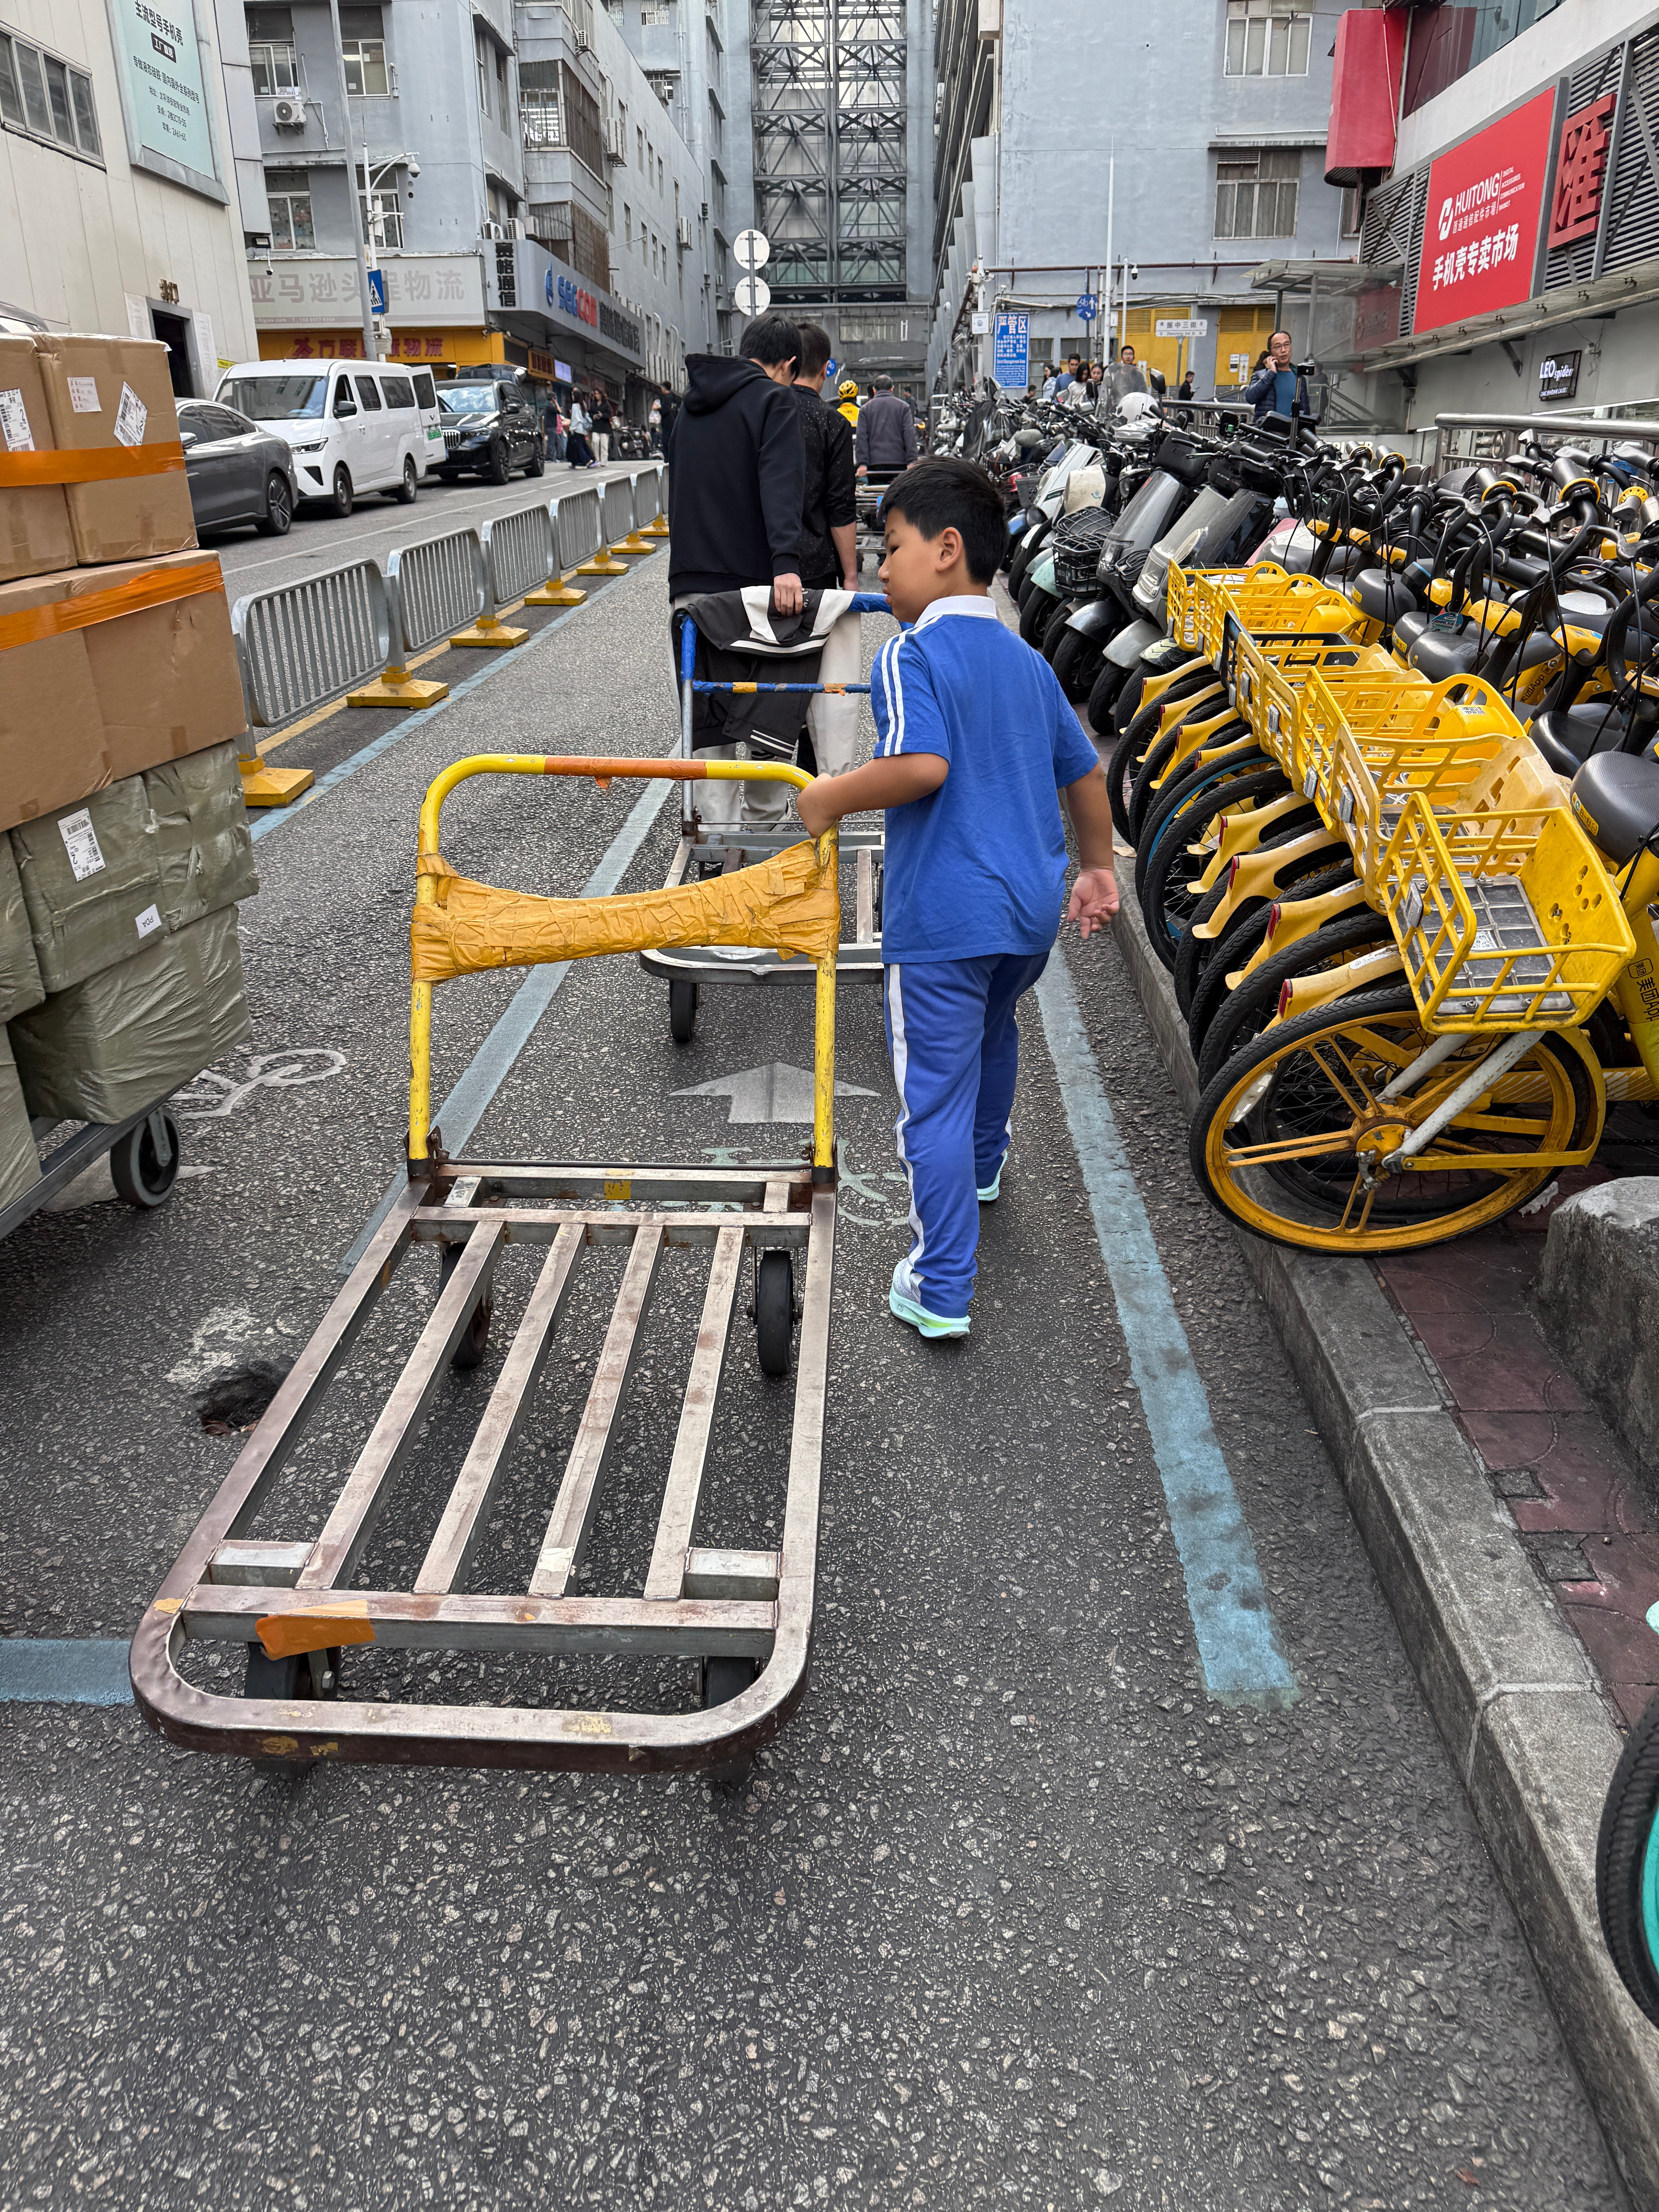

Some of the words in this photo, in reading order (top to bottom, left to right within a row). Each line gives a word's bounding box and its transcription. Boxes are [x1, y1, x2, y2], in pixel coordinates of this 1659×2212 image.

[135, 0, 183, 46] 主流型号手机壳
[1455, 172, 1500, 217] HUITONG
[1432, 223, 1519, 291] 手机壳专卖市场
[997, 316, 1027, 334] 严管区
[1539, 360, 1556, 379] LEO
[1554, 364, 1574, 381] spider
[142, 915, 154, 927] PDA
